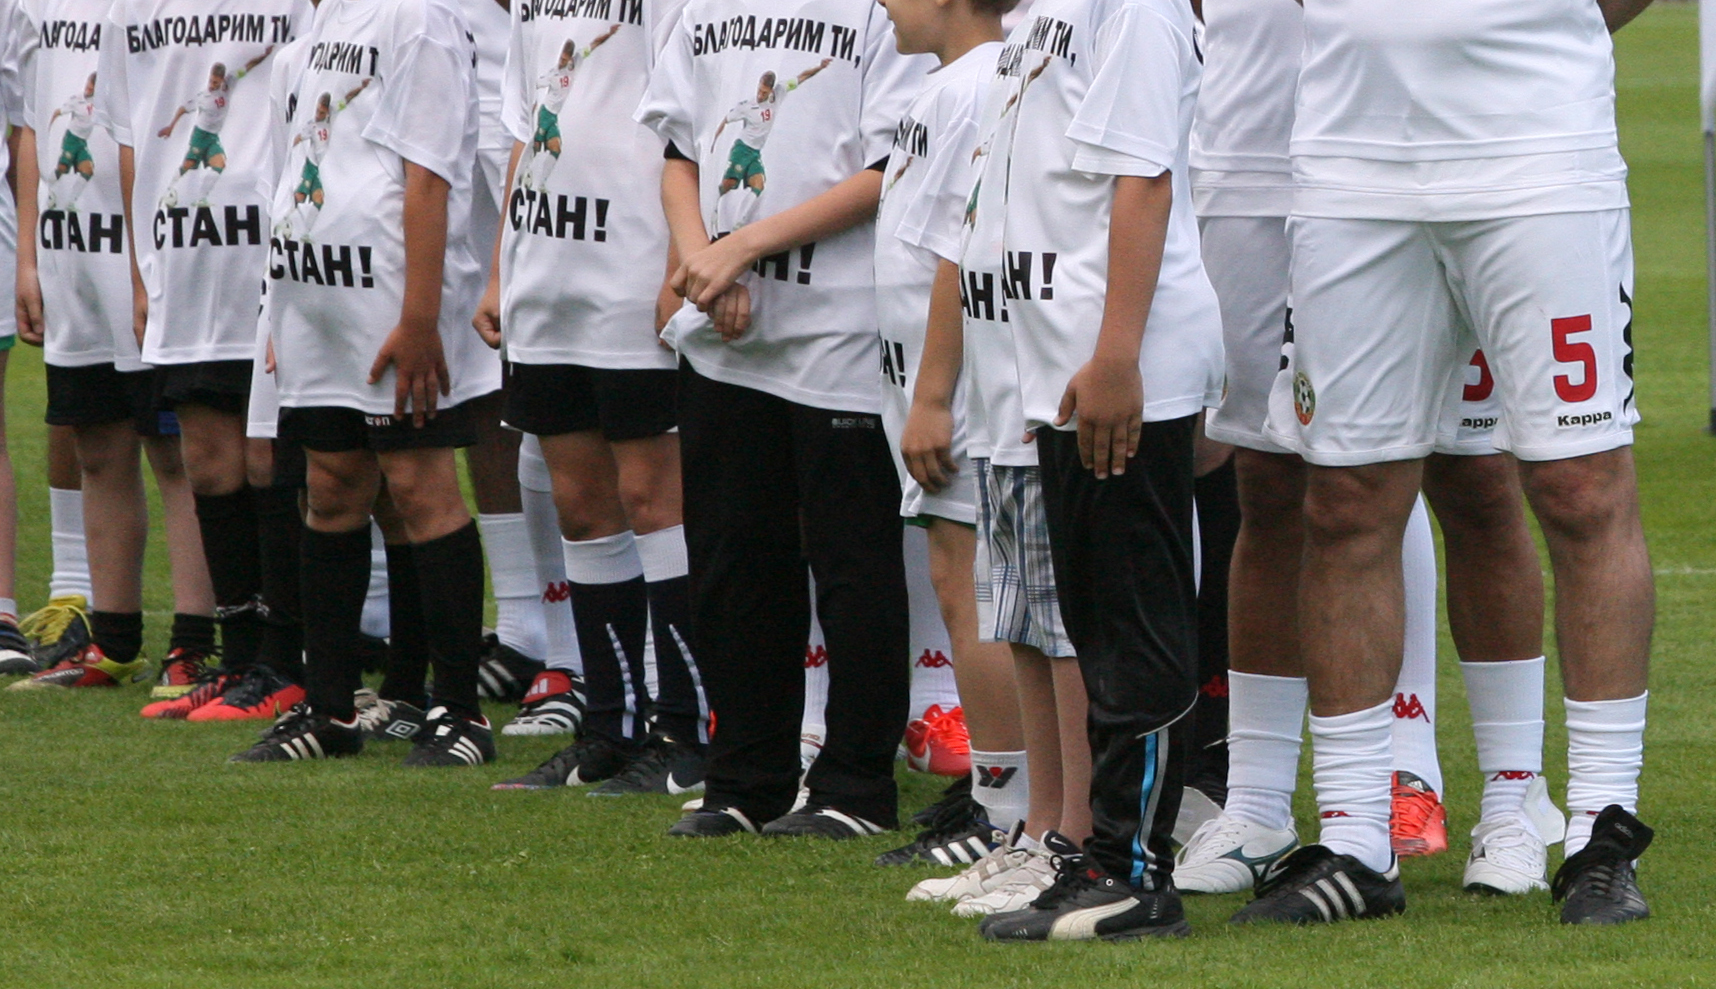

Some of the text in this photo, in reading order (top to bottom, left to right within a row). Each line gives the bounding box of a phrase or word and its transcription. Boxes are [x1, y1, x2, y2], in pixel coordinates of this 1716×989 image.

[126, 13, 265, 54] БЛАГОДАРИМ
[693, 14, 862, 69] БЛАГОДАРИМ ТИ,
[214, 96, 226, 109] 19
[760, 109, 771, 122] 19
[317, 128, 329, 142] 19
[153, 204, 262, 251] СТАН
[509, 187, 610, 243] СТАН!
[269, 237, 374, 289] СТАН!
[1551, 314, 1598, 403] 5
[1461, 417, 1498, 429] app
[1557, 411, 1612, 427] Kappa
